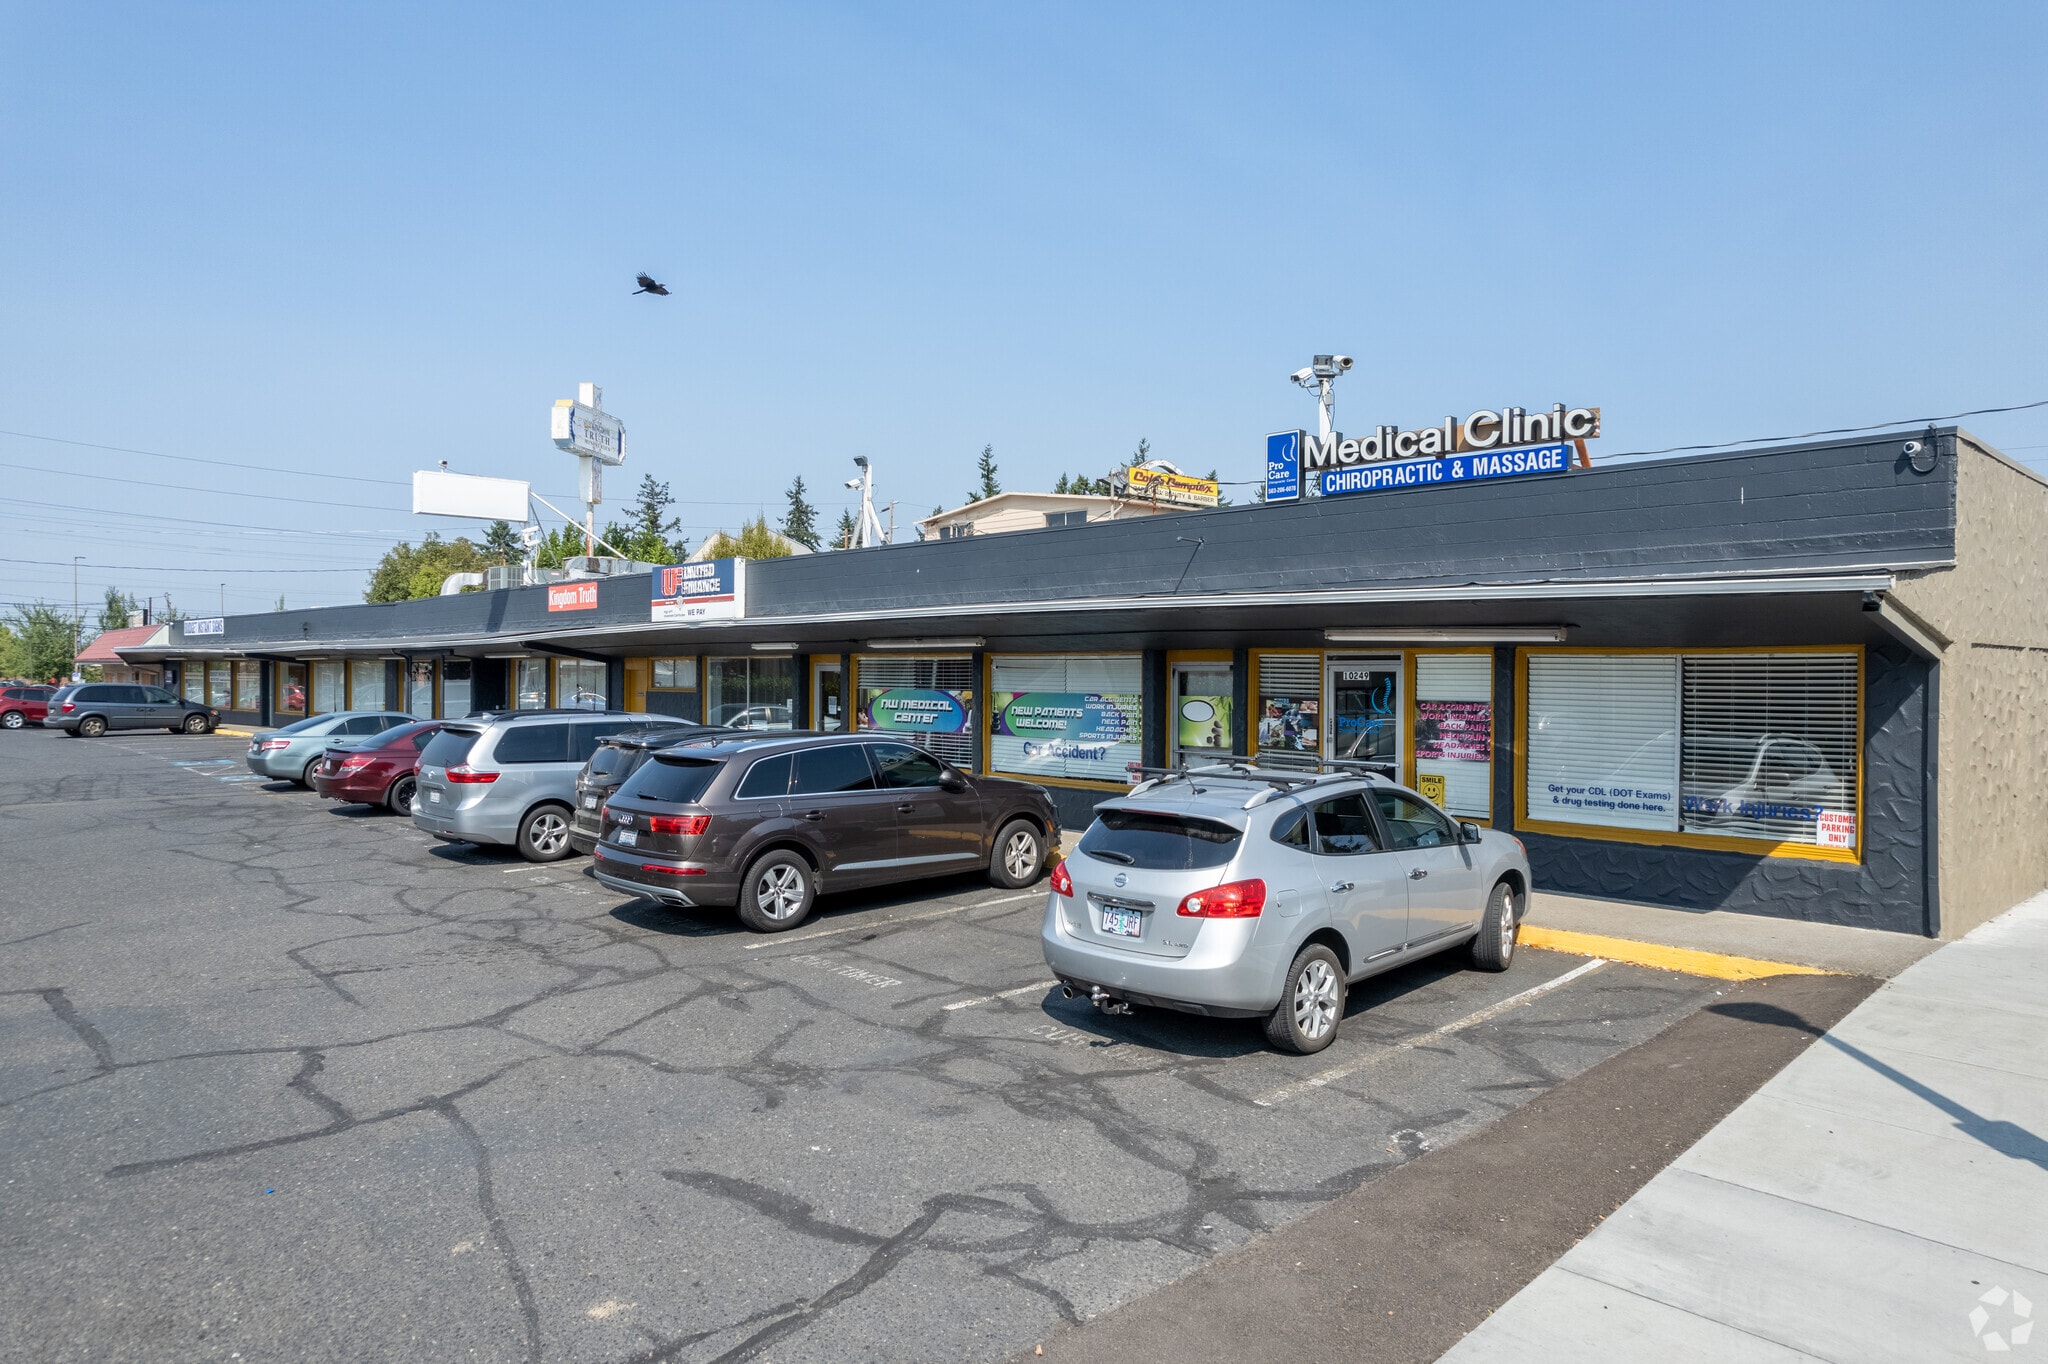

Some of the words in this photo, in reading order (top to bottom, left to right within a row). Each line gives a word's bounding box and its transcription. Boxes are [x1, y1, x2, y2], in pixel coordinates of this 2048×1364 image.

[584, 429, 610, 446] TRUTH
[1305, 416, 1456, 468] Medical
[1464, 403, 1596, 447] Clinic
[1268, 462, 1284, 470] Pro
[1326, 463, 1443, 492] CHIROPRACTIC
[1452, 460, 1464, 478] &
[1473, 449, 1562, 476] MASSAGE
[1268, 470, 1290, 479] Care
[549, 589, 577, 608] Kingdom
[578, 586, 597, 603] Truth
[1344, 672, 1369, 680] 10249
[1011, 706, 1033, 717] NEW
[1035, 707, 1084, 718] PATIENTS
[1420, 703, 1437, 711] CAR
[1016, 718, 1067, 729] WELCOME!
[1107, 733, 1138, 741] INJURIES
[1464, 733, 1485, 741] PAIN
[1048, 743, 1106, 760] Accident?
[1432, 742, 1485, 750] HEADACHES
[1415, 750, 1445, 758] SPORTS
[1448, 752, 1485, 760] INJURIES
[1421, 776, 1443, 784] SMILE
[1548, 784, 1563, 793] Get
[1566, 786, 1585, 795] your
[1588, 787, 1606, 796] CDL
[1609, 788, 1633, 798] (DOT
[1636, 790, 1671, 801] Exams)
[1552, 796, 1559, 804] &
[1562, 797, 1582, 807] drug
[1584, 798, 1615, 810] testing
[1617, 800, 1640, 809] done
[1642, 802, 1666, 812] here.
[1683, 795, 1733, 814] Work
[1740, 799, 1824, 821] Injuries?
[1819, 814, 1857, 824] CUSTOMER
[1821, 823, 1855, 834] PARKING
[1828, 833, 1847, 843] ONLY
[1105, 913, 1119, 927] 745
[1124, 915, 1139, 928] JRF
